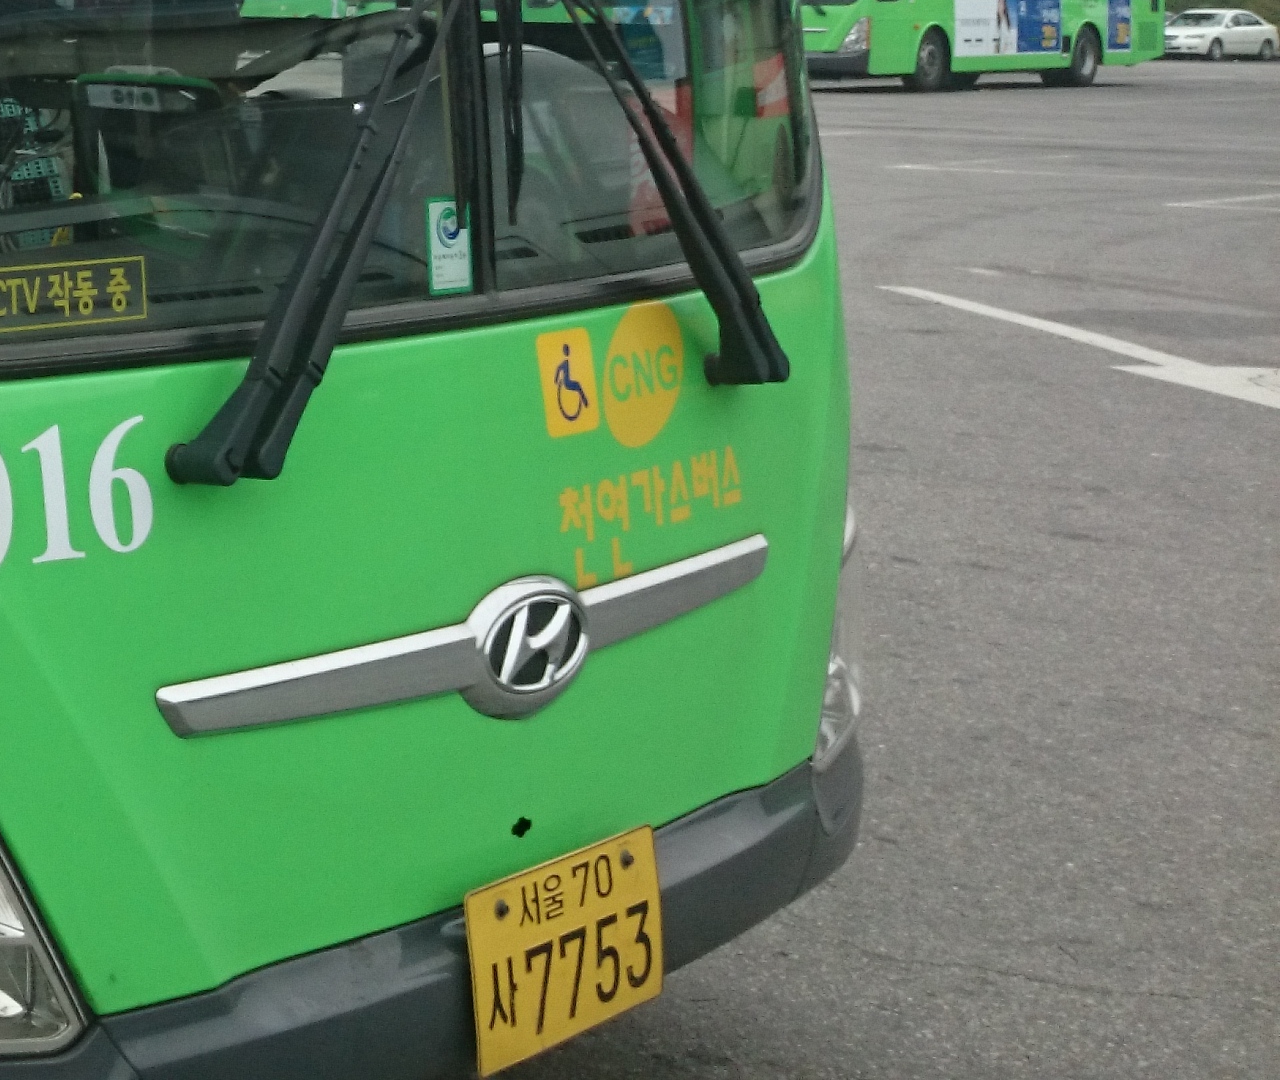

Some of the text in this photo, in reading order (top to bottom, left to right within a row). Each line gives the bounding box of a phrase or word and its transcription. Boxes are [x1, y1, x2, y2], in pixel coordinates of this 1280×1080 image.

[46, 271, 98, 318] 작동
[106, 267, 132, 312] 중
[608, 344, 680, 403] CNG
[558, 444, 743, 590] 천연가스버스
[519, 853, 614, 927] 서울 70
